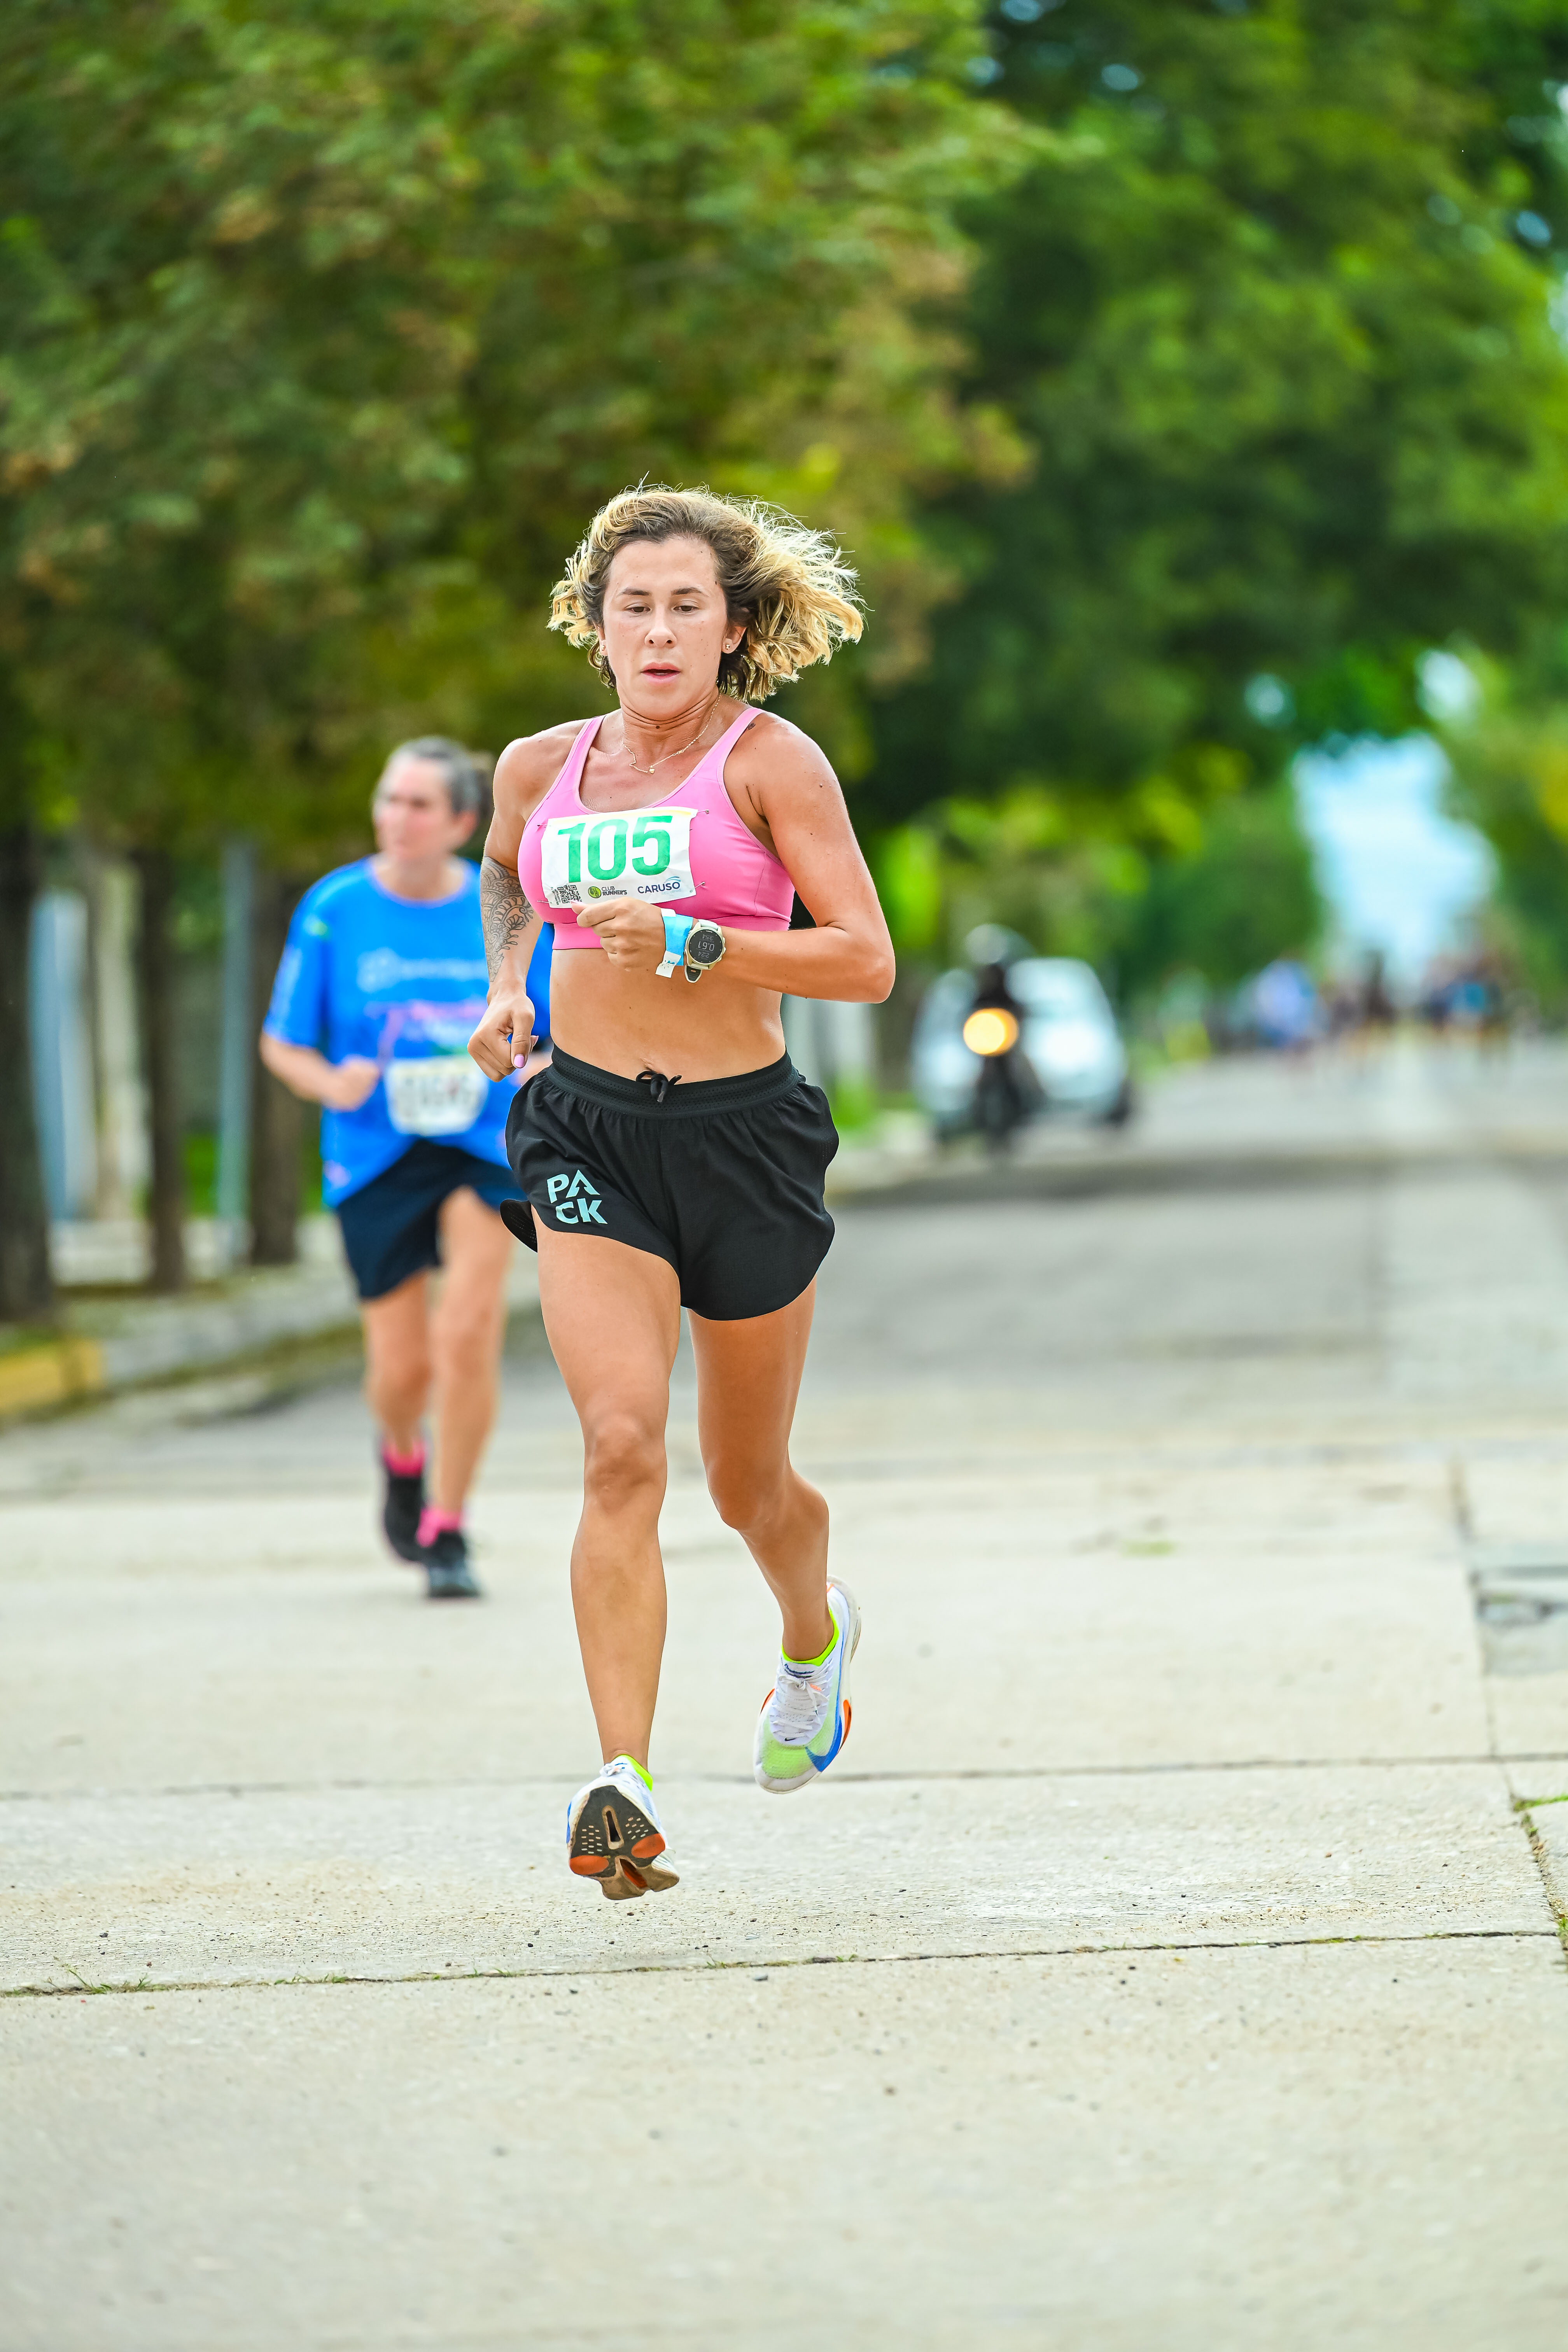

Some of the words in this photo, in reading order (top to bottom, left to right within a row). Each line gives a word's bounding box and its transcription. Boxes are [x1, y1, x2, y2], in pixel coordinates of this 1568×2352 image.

[558, 816, 673, 883] 105
[637, 882, 680, 894] CARUSO
[698, 941, 714, 951] 0.61
